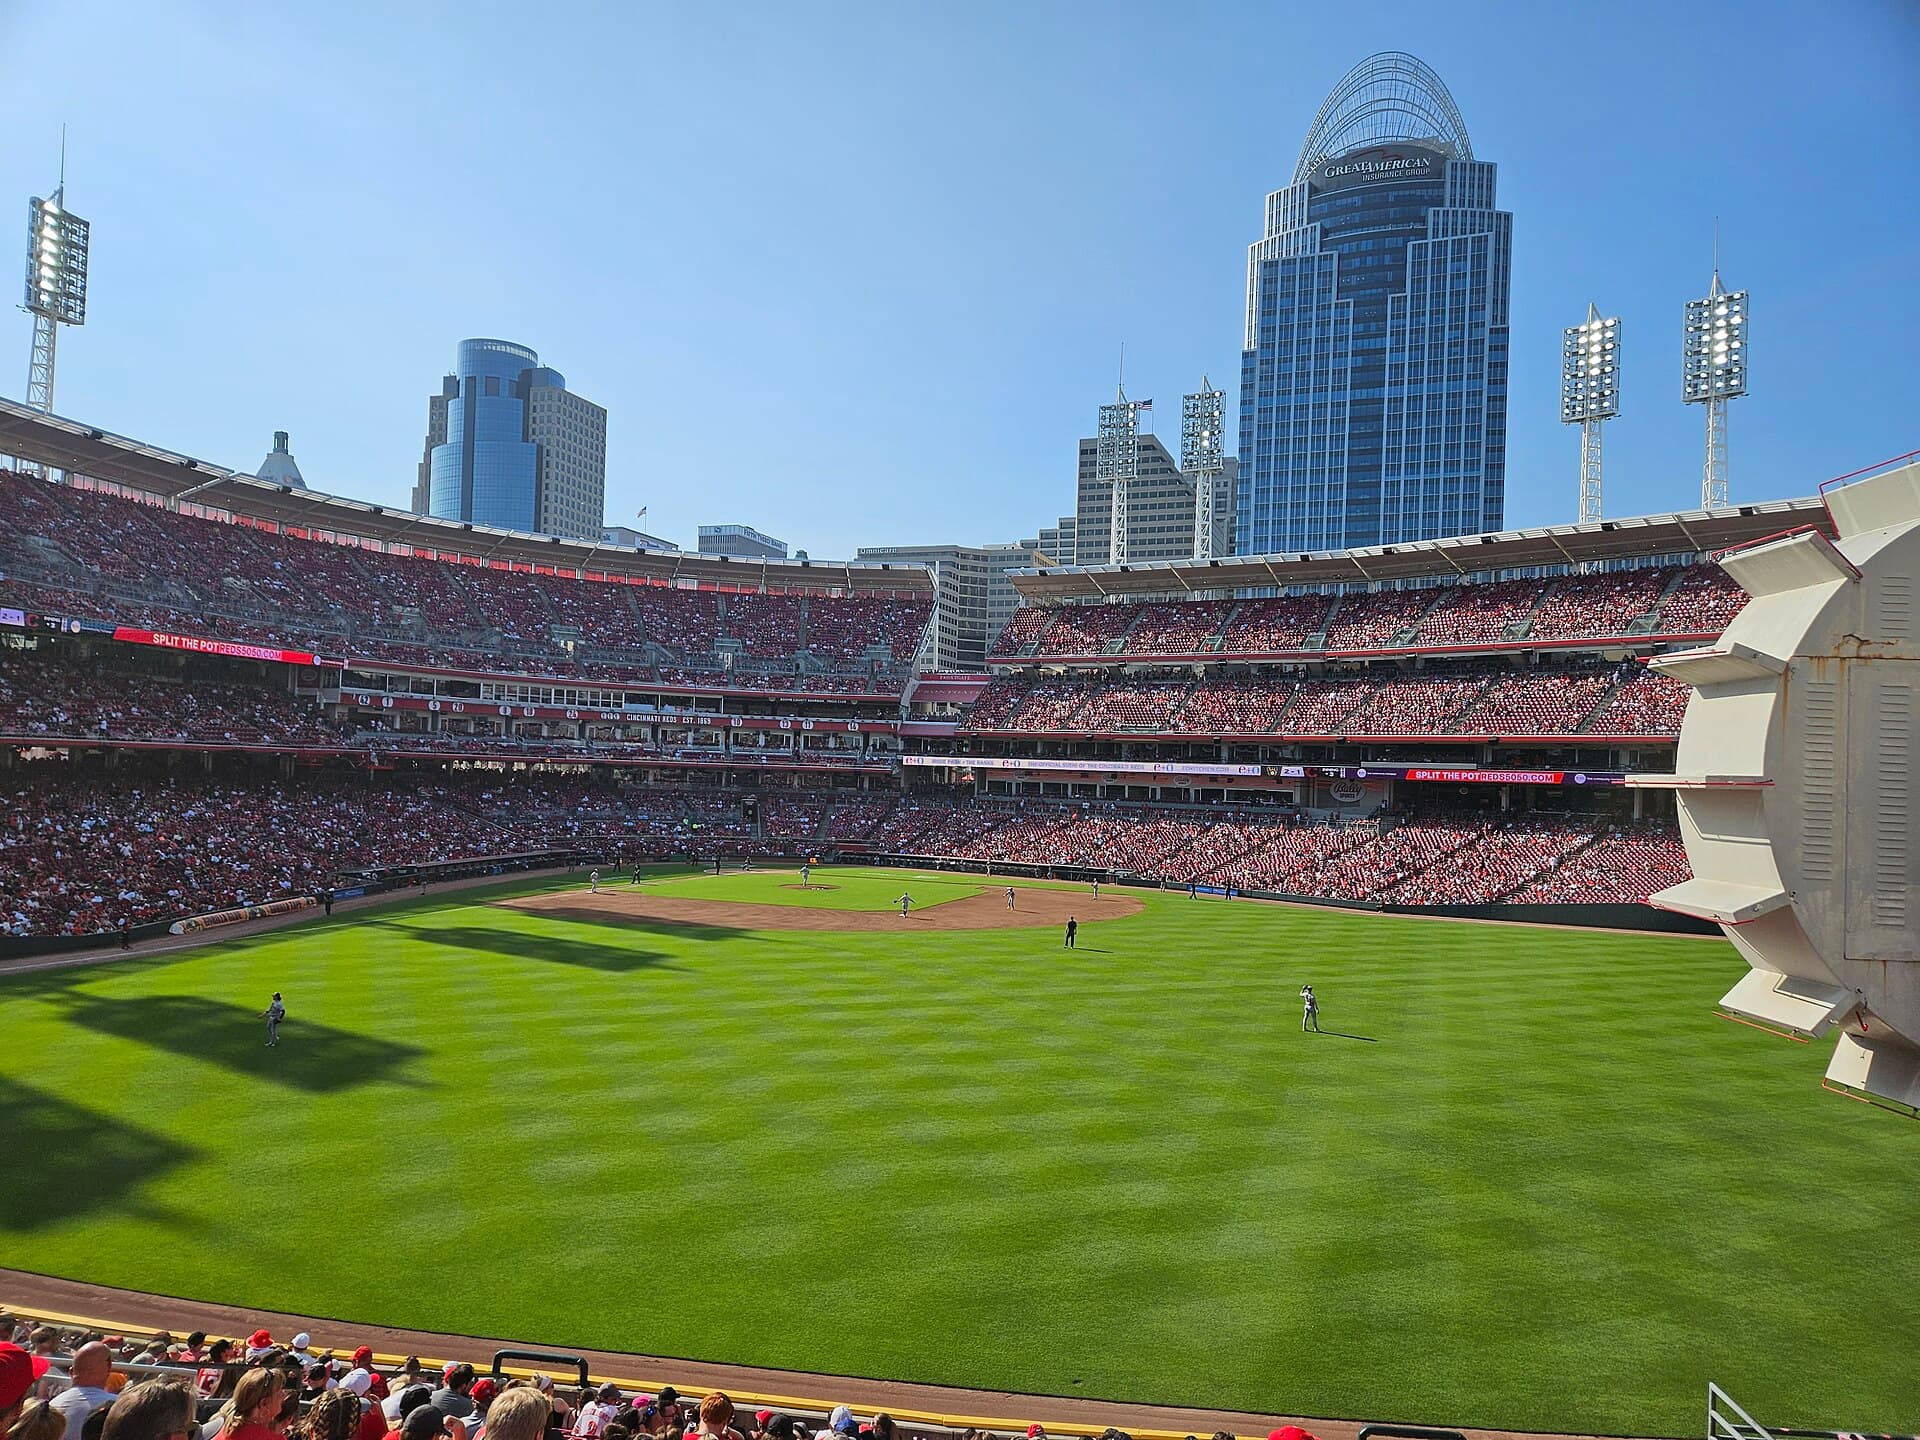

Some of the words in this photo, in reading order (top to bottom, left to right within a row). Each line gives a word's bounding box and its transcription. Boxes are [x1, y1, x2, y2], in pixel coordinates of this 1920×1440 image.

[1362, 171, 1404, 181] INSURANCE
[1406, 167, 1430, 176] GROUP
[152, 633, 180, 647] SPLIT
[181, 638, 199, 649] THE
[200, 640, 220, 652] POT
[626, 713, 660, 723] CINCINNATI
[662, 716, 677, 724] REDS
[682, 716, 696, 724] EST.
[1415, 770, 1441, 779] SPLIT
[1442, 771, 1460, 780] THE
[1461, 771, 1480, 780] POT
[1481, 772, 1554, 782] REDS5050.COM
